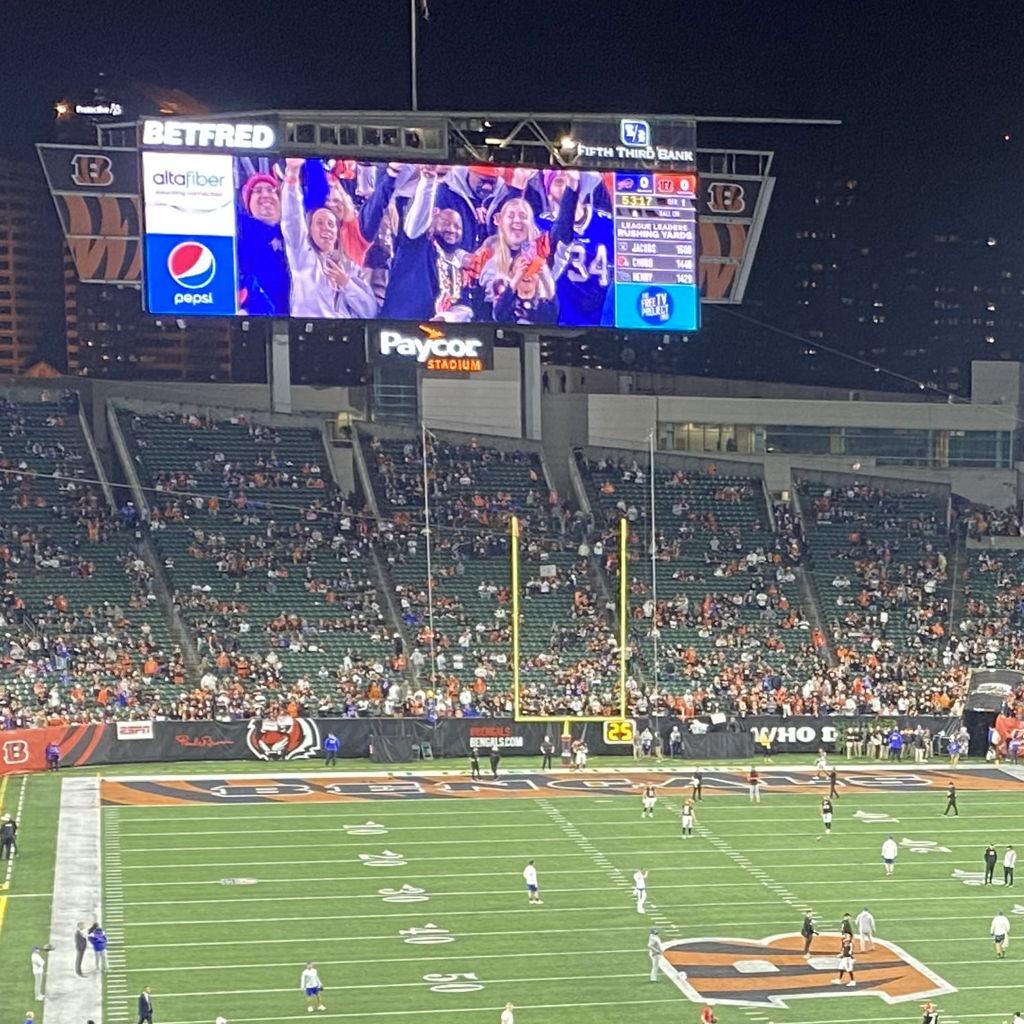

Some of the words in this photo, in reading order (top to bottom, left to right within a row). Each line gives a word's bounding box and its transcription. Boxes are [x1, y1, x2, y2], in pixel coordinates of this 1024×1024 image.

[143, 120, 275, 149] BETFRED
[577, 145, 614, 158] FIFTH
[616, 146, 656, 159] THIRD
[657, 149, 694, 161] BANK
[152, 170, 225, 189] altafiber
[617, 228, 660, 239] RUSHING
[661, 231, 693, 240] YARDS
[621, 222, 652, 231] LEAGUE
[653, 223, 688, 232] LEADERS
[174, 291, 214, 305] pepsi
[379, 330, 483, 363] Paycor
[427, 358, 482, 371] STADIUM
[469, 736, 524, 748] BENGALS.COM
[750, 726, 817, 743] WHO
